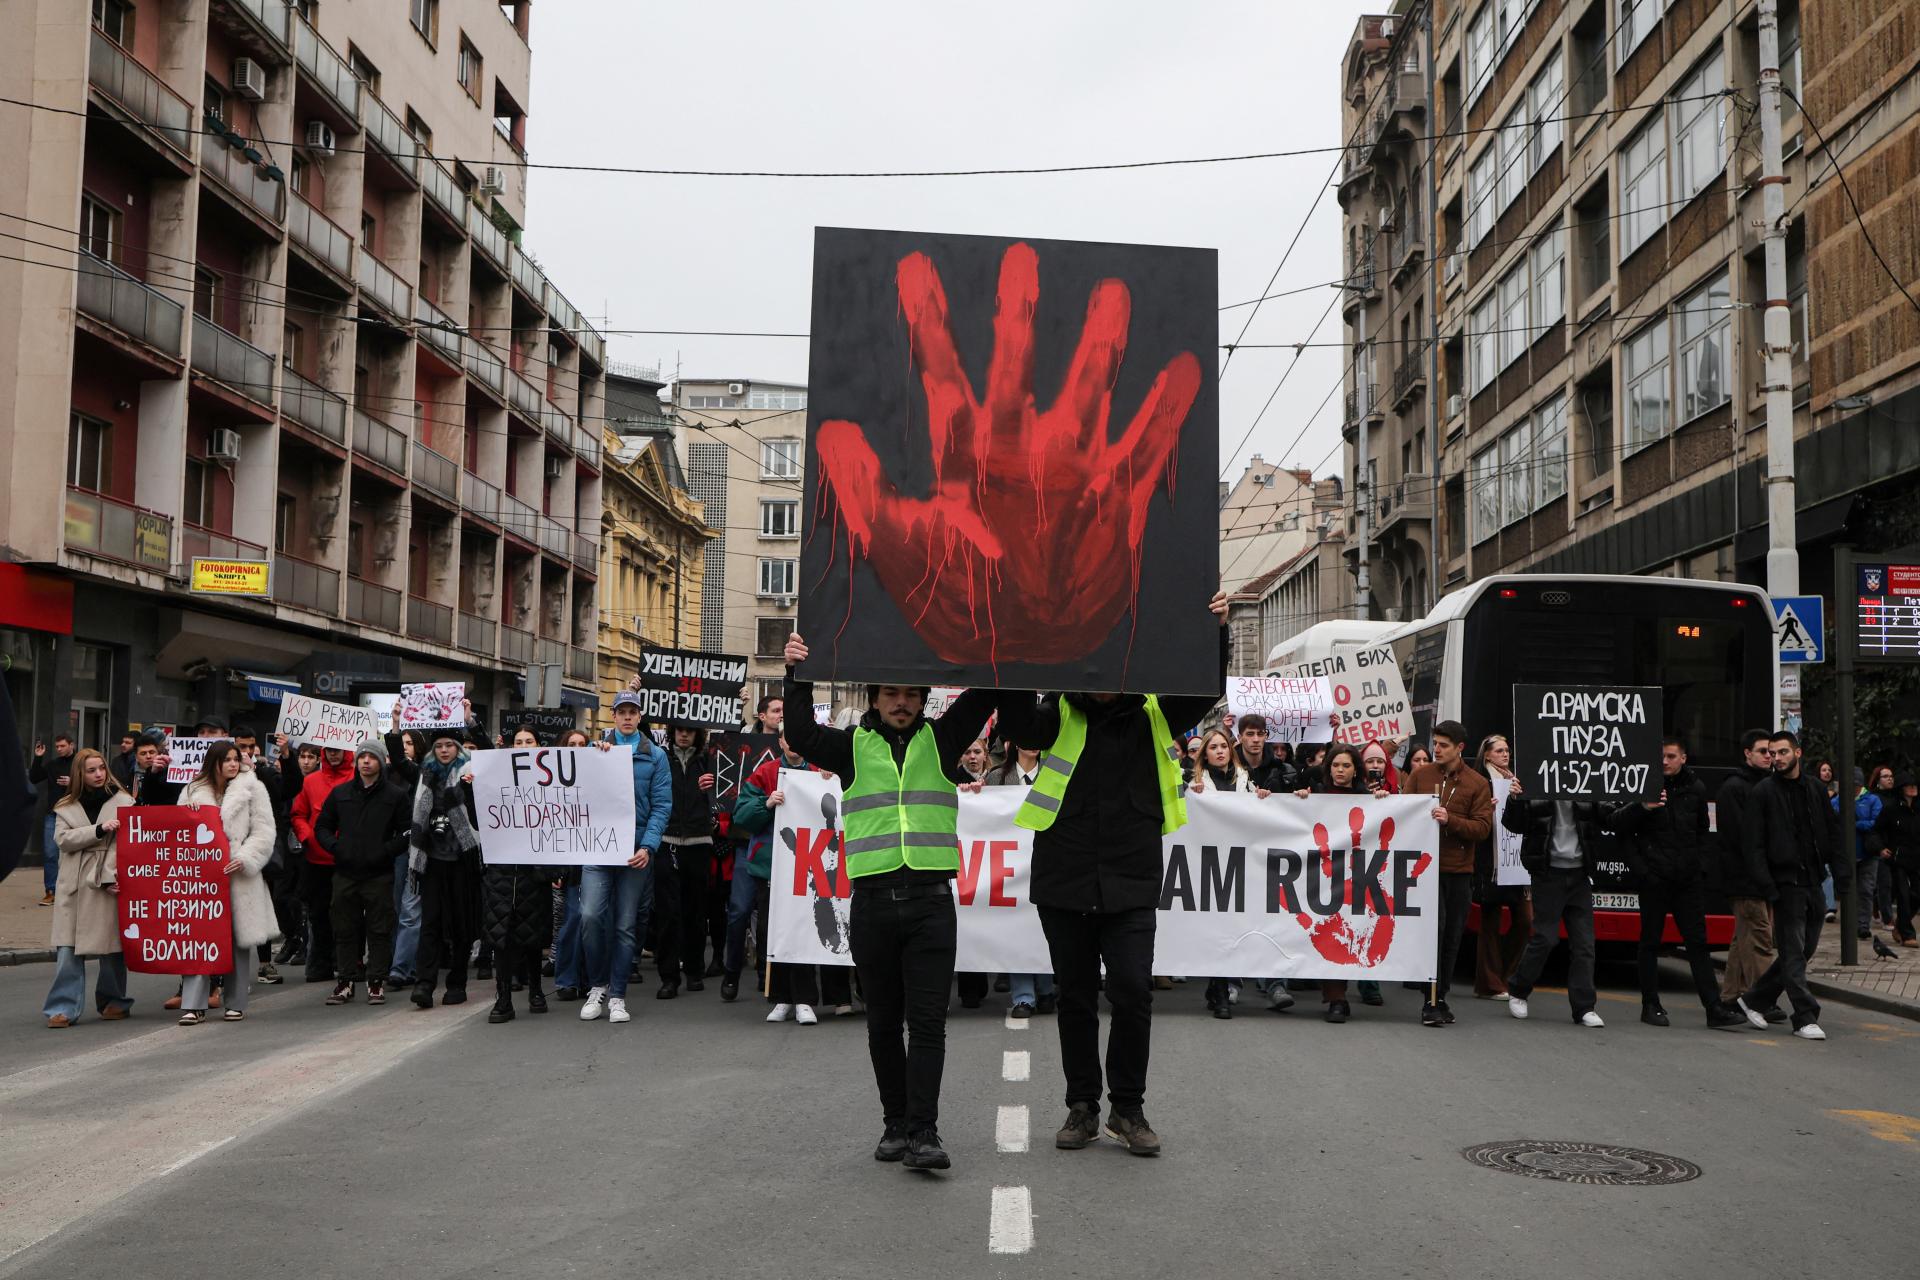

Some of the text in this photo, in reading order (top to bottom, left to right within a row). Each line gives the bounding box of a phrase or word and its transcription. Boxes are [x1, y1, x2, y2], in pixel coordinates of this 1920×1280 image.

[200, 563, 260, 575] FOTOKOPIRNICA
[642, 652, 747, 683] УЈЕДИЊЕНИ
[1356, 648, 1394, 667] БИХ
[676, 677, 703, 692] ЗА
[1237, 678, 1318, 695] ЗАТВОРЕНИ
[1361, 678, 1388, 700] ДА
[288, 697, 372, 727] КО РЕЖИРА
[638, 688, 743, 725] ОБРАЗОВАЊЕ
[1236, 694, 1324, 710] ФАКУЛТЕТИ
[1366, 701, 1404, 718] САМО
[1538, 692, 1646, 724] ДРАМСКА
[283, 717, 310, 736] ОВУ
[1552, 724, 1627, 758] ПАУЗА
[511, 750, 577, 787] FSU
[1537, 759, 1650, 794] 11:52-12:07
[500, 786, 583, 805] FAKULTET
[488, 803, 590, 829] SOLIDARNIH
[530, 827, 619, 853] UMETNIKA
[156, 847, 223, 862] НЕ БОЈИМО
[127, 865, 201, 878] СИВЕ ДАНЕ
[1158, 844, 1246, 913] AM
[1266, 848, 1422, 916] RUKE
[162, 880, 218, 895] БОЈИМО
[129, 899, 224, 920] НЕ МРЗИМО
[142, 938, 220, 962] ВОЛИМО
